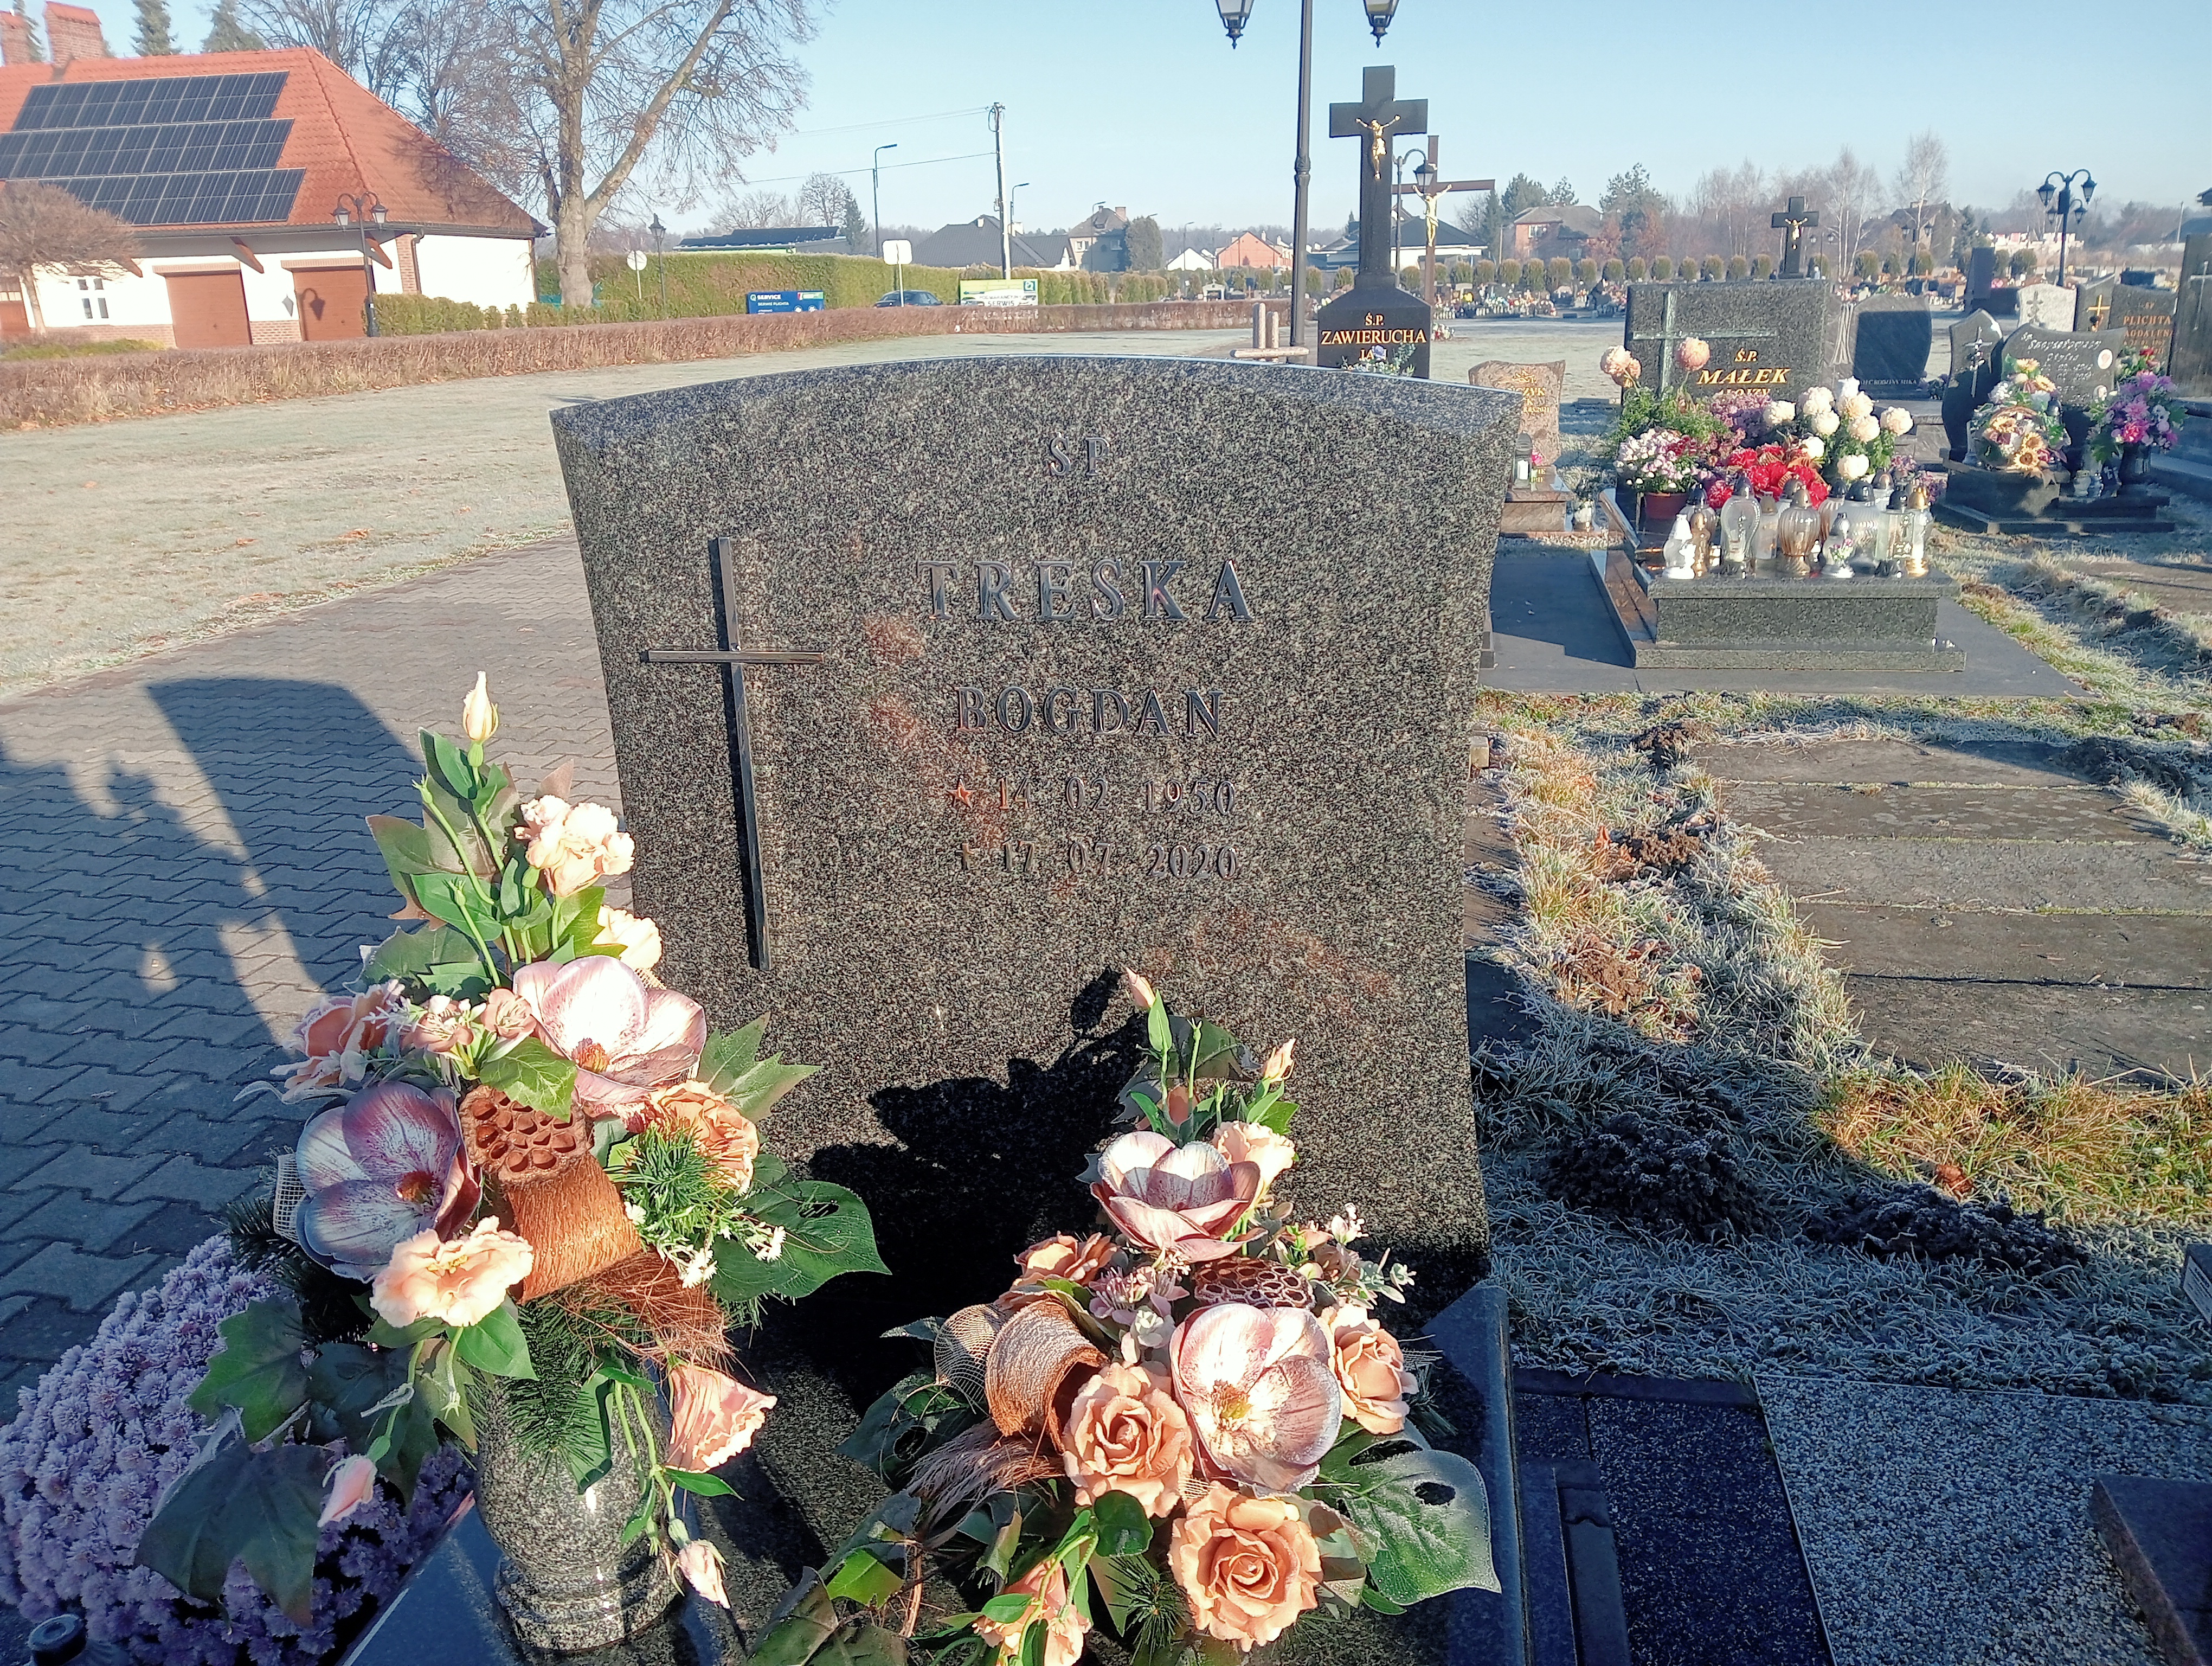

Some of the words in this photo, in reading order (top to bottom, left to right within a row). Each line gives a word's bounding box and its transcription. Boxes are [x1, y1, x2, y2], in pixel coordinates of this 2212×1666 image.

[1321, 329, 1427, 345] ZAWIERUCHA
[1696, 368, 1792, 385] MAŁEK
[917, 558, 1255, 622] TRESKA
[955, 686, 1223, 736] BOGDAN
[1146, 843, 1238, 880] 2020
